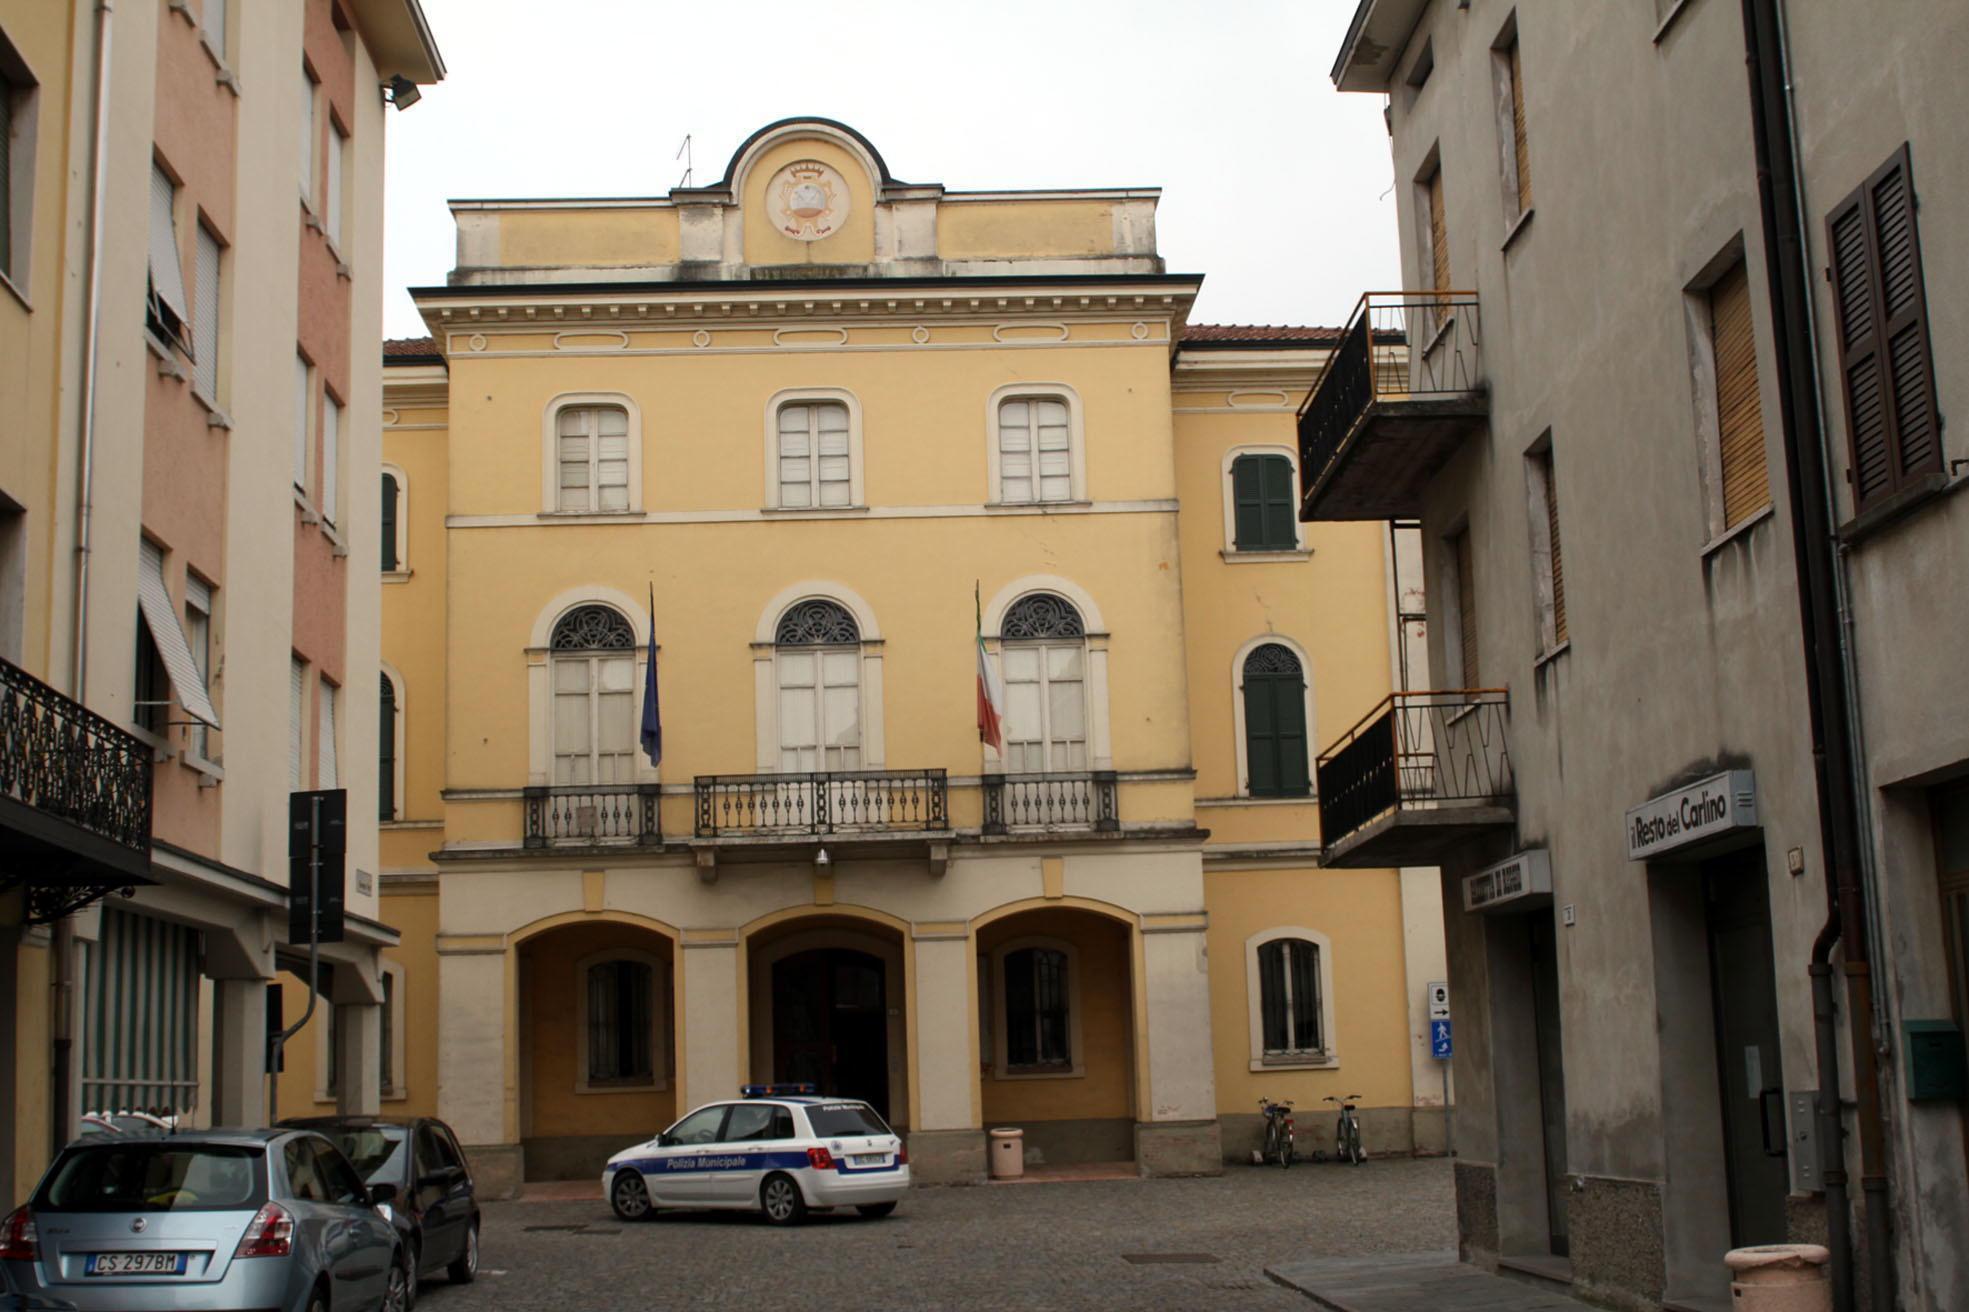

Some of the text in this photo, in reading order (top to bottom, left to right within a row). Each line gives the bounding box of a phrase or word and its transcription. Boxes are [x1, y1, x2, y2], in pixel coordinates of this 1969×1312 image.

[1636, 815, 1666, 848] Resto
[1667, 811, 1680, 836] del
[1681, 790, 1726, 831] Carlino
[667, 1155, 746, 1169] Polizia Municipale
[97, 1256, 117, 1271] CS
